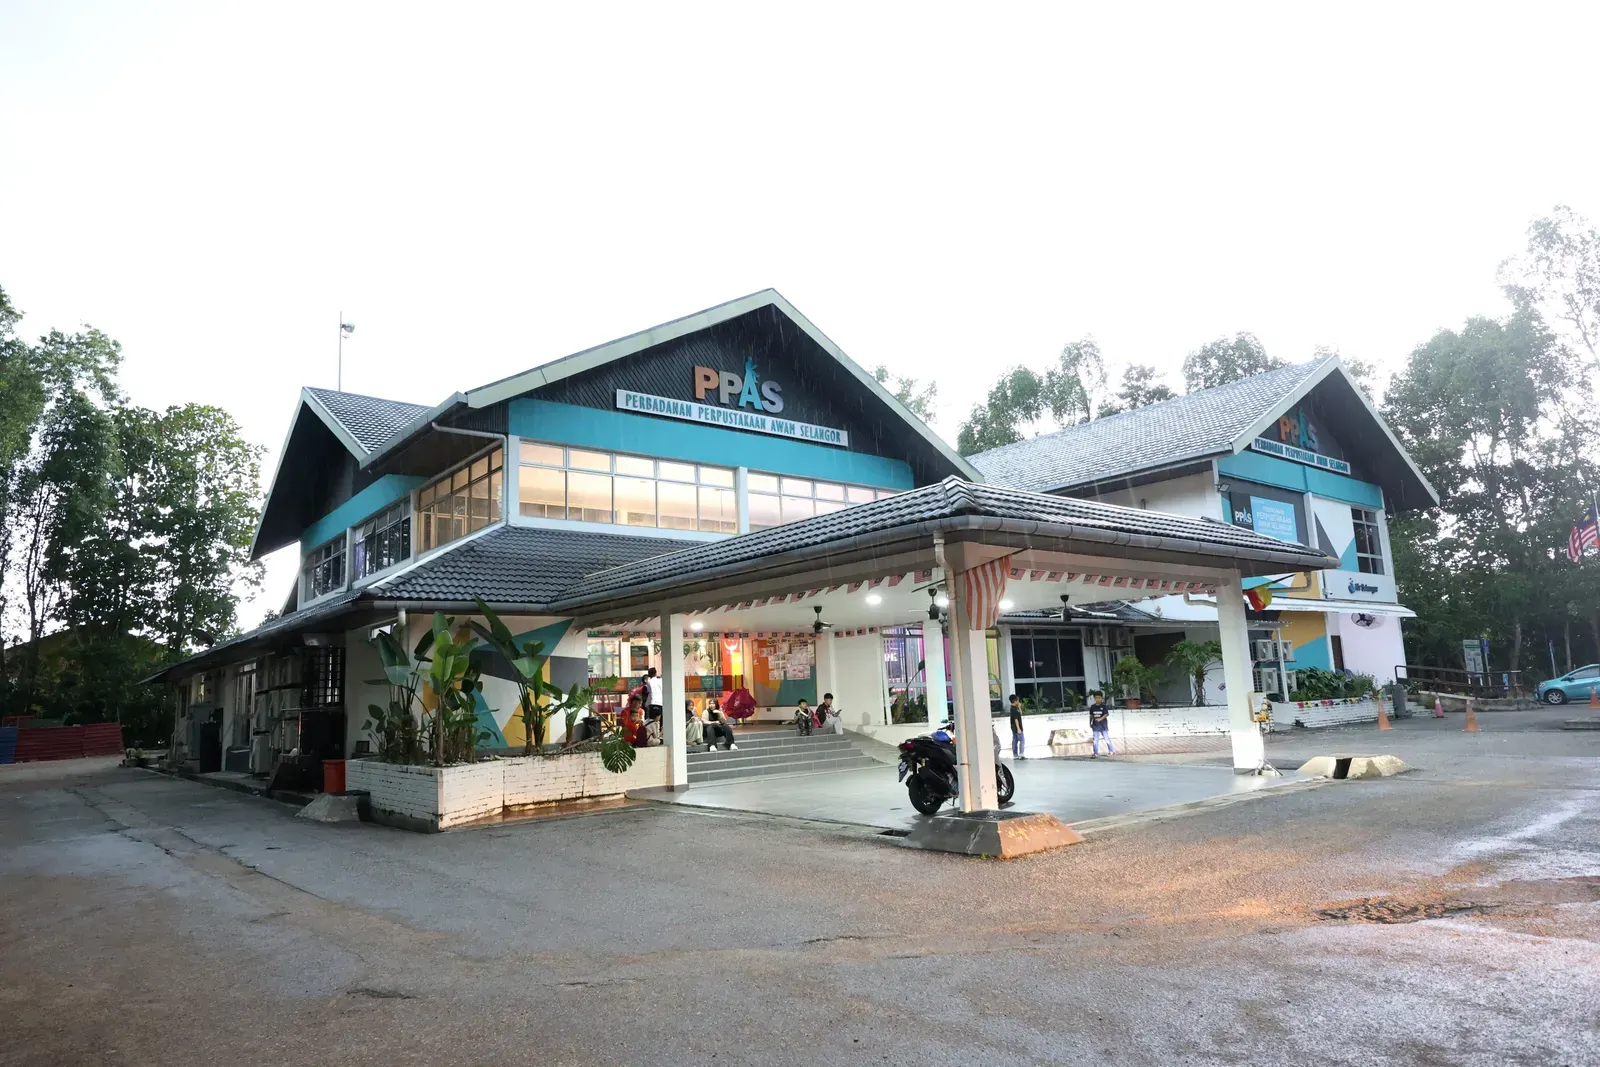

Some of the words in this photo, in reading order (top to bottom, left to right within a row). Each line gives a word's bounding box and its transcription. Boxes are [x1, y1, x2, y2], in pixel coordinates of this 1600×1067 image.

[694, 357, 784, 414] PPAS
[625, 393, 692, 417] PERBADANAN
[698, 403, 766, 430] PERPUSTAKAAN
[770, 420, 796, 435] AWAM
[799, 425, 841, 444] SELANGOR
[1279, 409, 1319, 452] PPAS
[1234, 506, 1252, 524] PPAS
